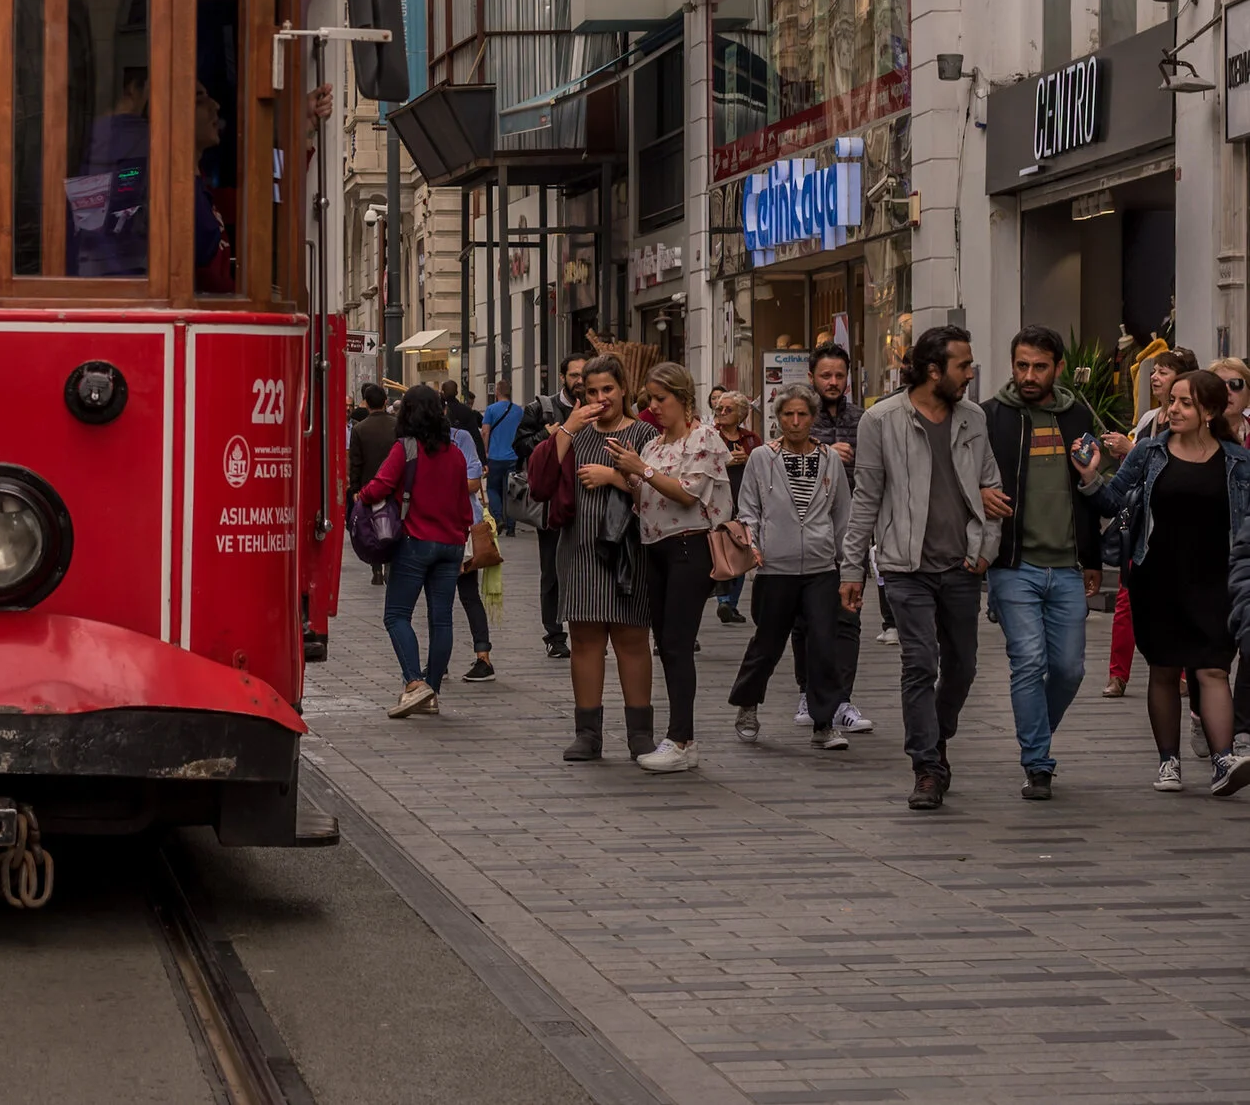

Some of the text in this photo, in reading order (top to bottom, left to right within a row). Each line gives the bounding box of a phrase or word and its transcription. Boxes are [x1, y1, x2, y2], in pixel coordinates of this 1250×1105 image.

[1034, 56, 1097, 160] CENTRO
[742, 156, 861, 267] Çetinkaya
[252, 379, 284, 424] 223
[254, 464, 292, 478] ALO 153
[220, 507, 274, 525] ASILMAK
[216, 535, 234, 553] VE
